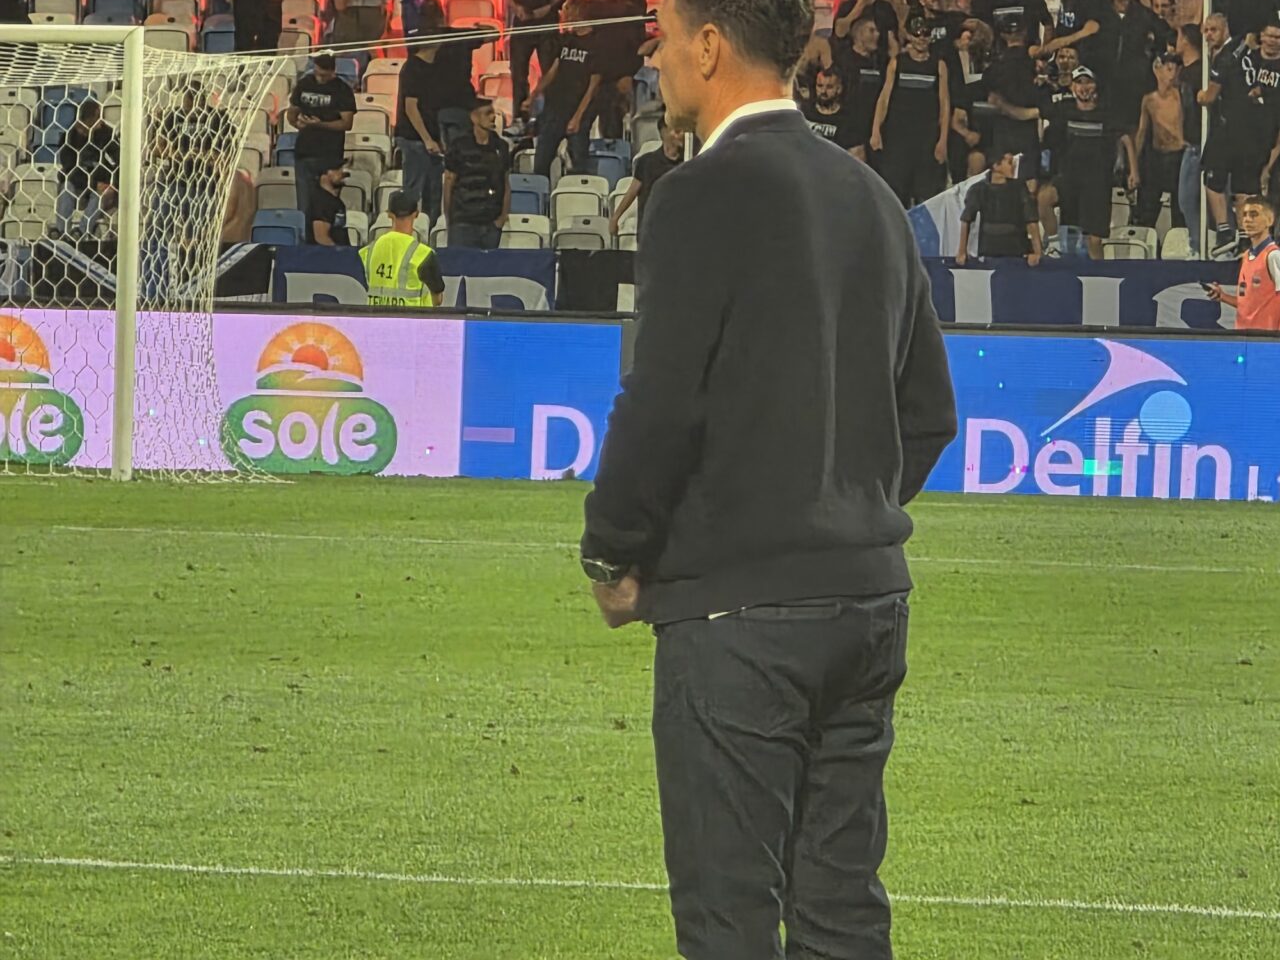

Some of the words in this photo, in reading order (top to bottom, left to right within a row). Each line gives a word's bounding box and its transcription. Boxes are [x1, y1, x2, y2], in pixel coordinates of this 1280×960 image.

[376, 263, 393, 279] 41
[240, 402, 377, 466] sole
[963, 417, 1232, 500] Delfin
